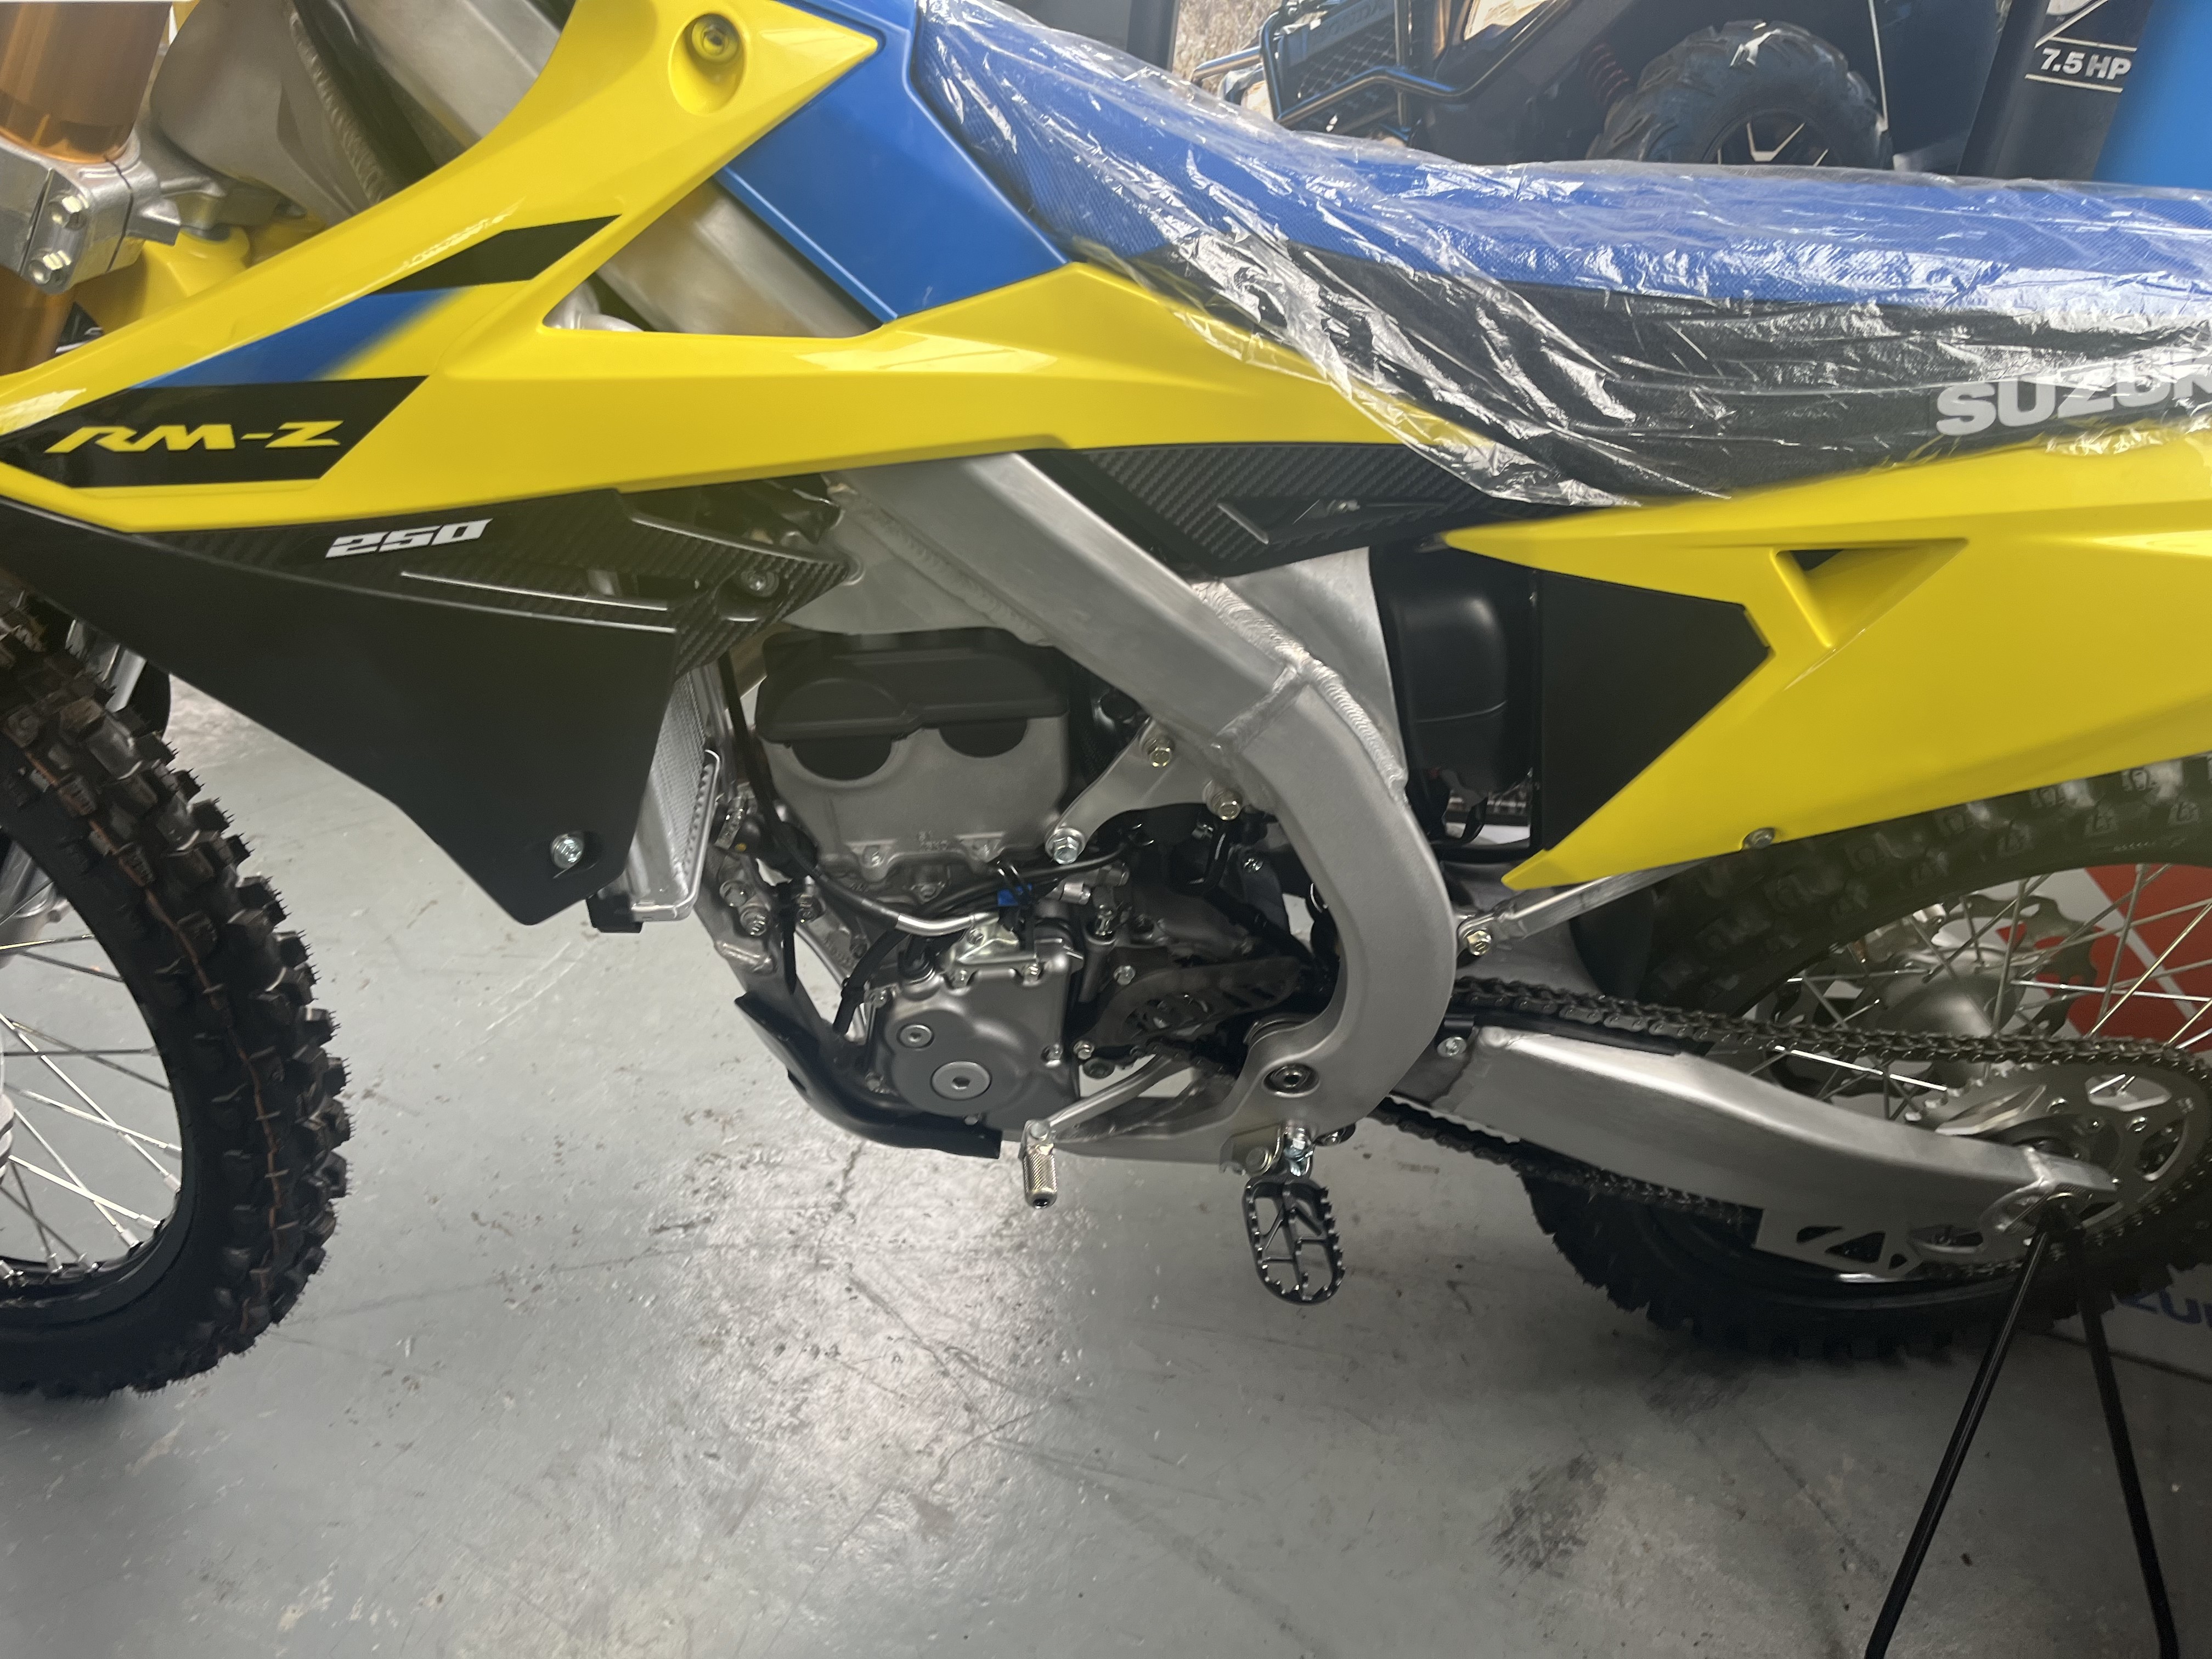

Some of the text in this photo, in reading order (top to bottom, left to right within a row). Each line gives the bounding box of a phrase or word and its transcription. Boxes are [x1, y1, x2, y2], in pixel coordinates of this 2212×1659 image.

[2040, 48, 2131, 80] 7.5 HP
[45, 421, 344, 453] RM-Z
[325, 518, 492, 558] 250
